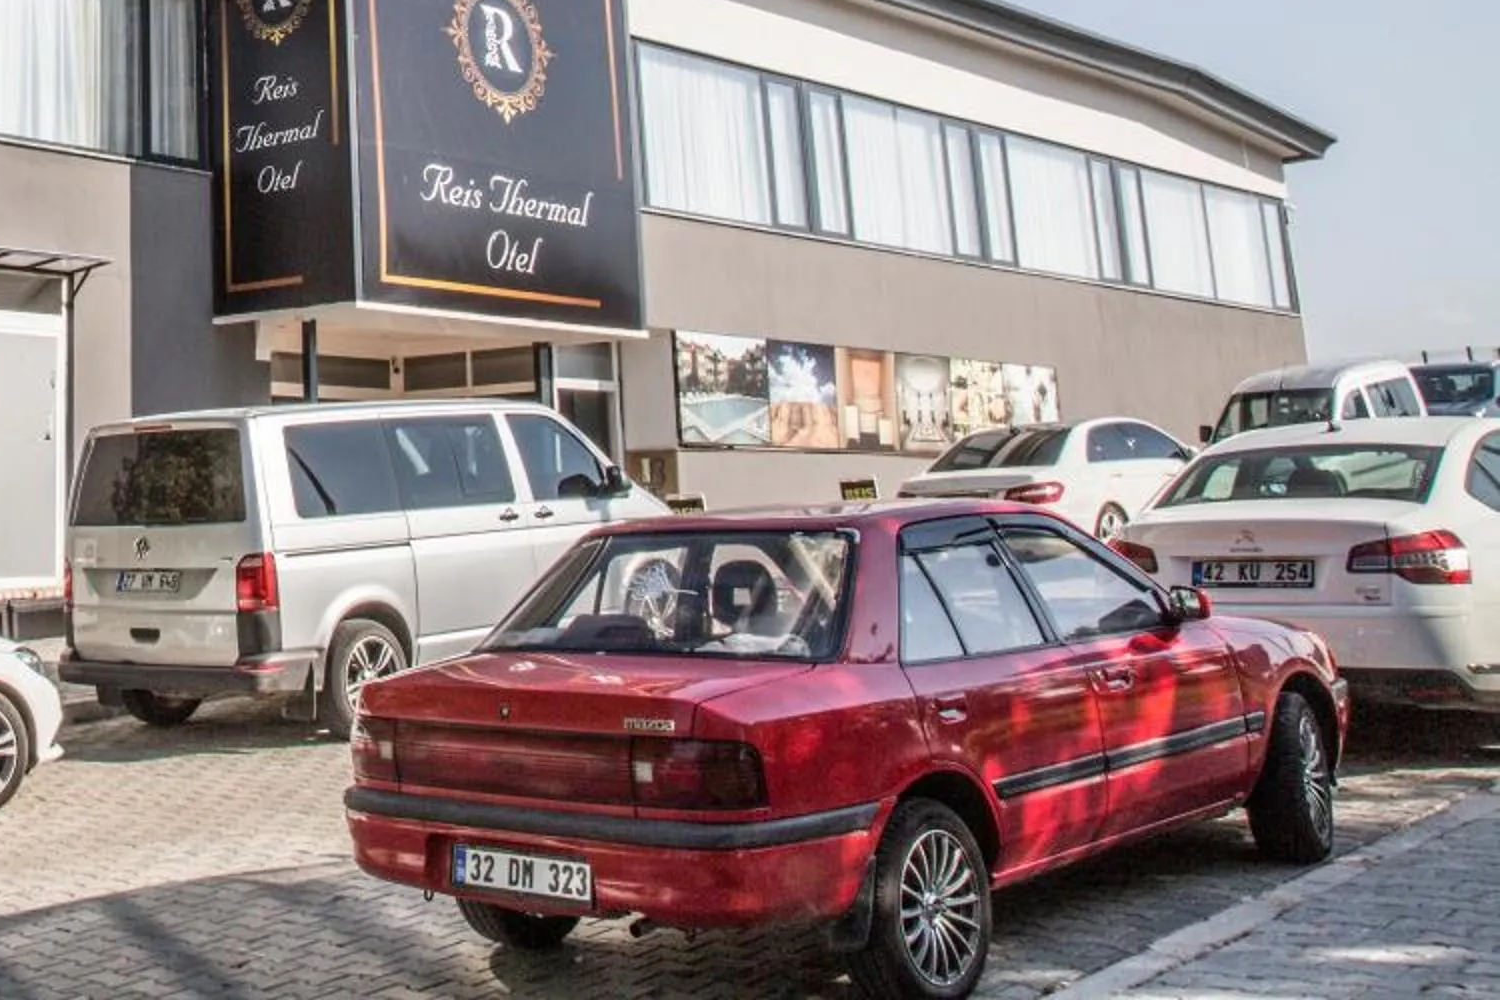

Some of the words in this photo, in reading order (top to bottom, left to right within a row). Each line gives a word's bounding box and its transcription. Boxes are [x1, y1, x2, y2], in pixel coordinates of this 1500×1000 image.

[480, 3, 524, 73] R
[252, 74, 300, 105] Reis
[236, 109, 324, 153] Thermal
[257, 159, 303, 193] Otel
[420, 163, 483, 208] Reis
[489, 175, 595, 226] Thermal
[486, 229, 543, 274] Otel
[1203, 564, 1224, 581] 42
[1238, 564, 1260, 581] KU
[1275, 563, 1309, 581] 254
[470, 854, 495, 883] 32
[508, 858, 534, 889] DM
[548, 863, 588, 896] 323
